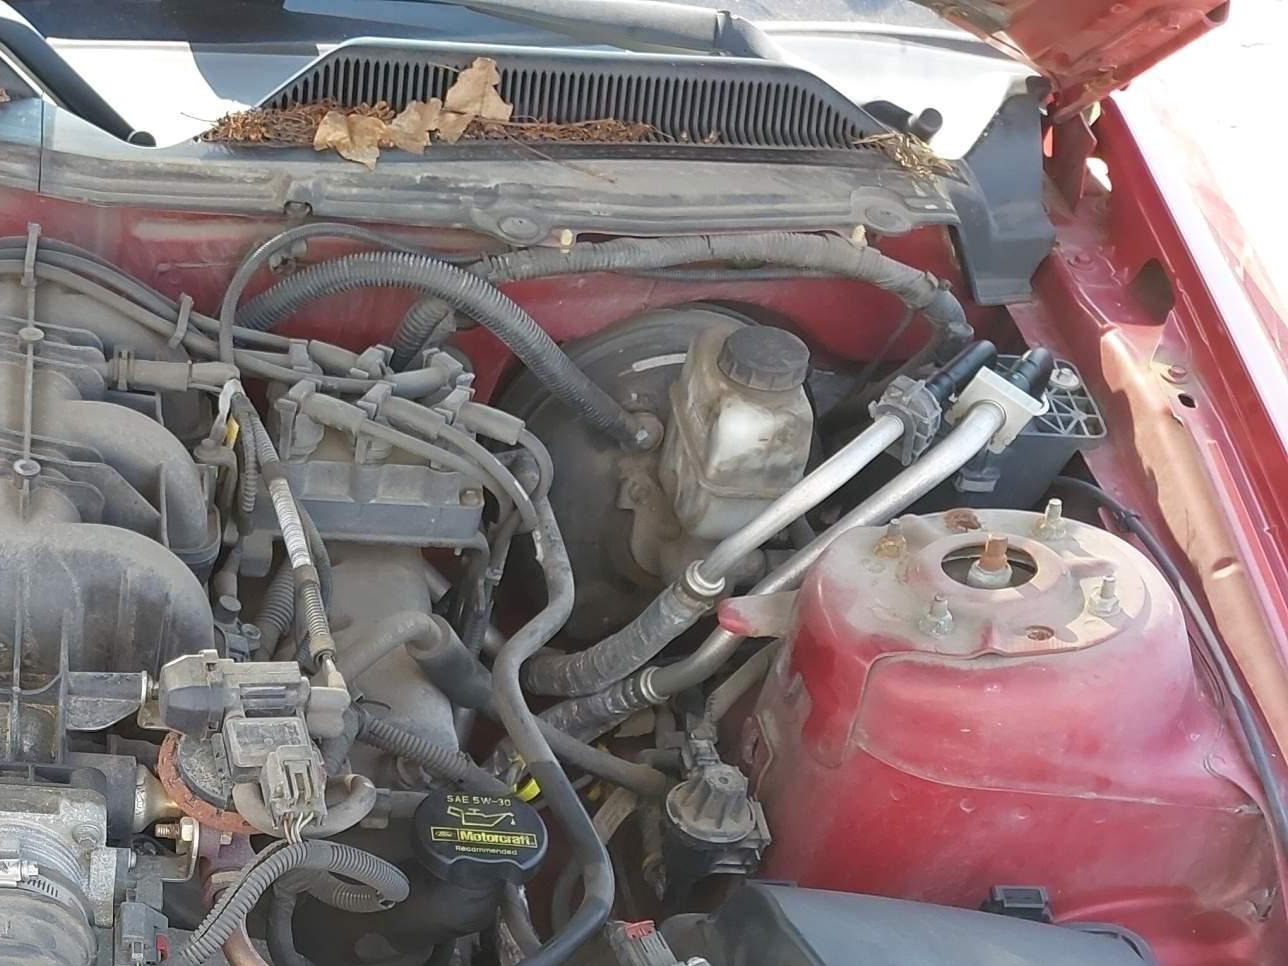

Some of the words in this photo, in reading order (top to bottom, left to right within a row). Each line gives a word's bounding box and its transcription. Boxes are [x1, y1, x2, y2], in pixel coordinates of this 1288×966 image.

[446, 795, 469, 804] SAE
[472, 796, 511, 807] 5W-30
[460, 830, 530, 845] Motorcraft
[455, 845, 518, 856] Recommended
